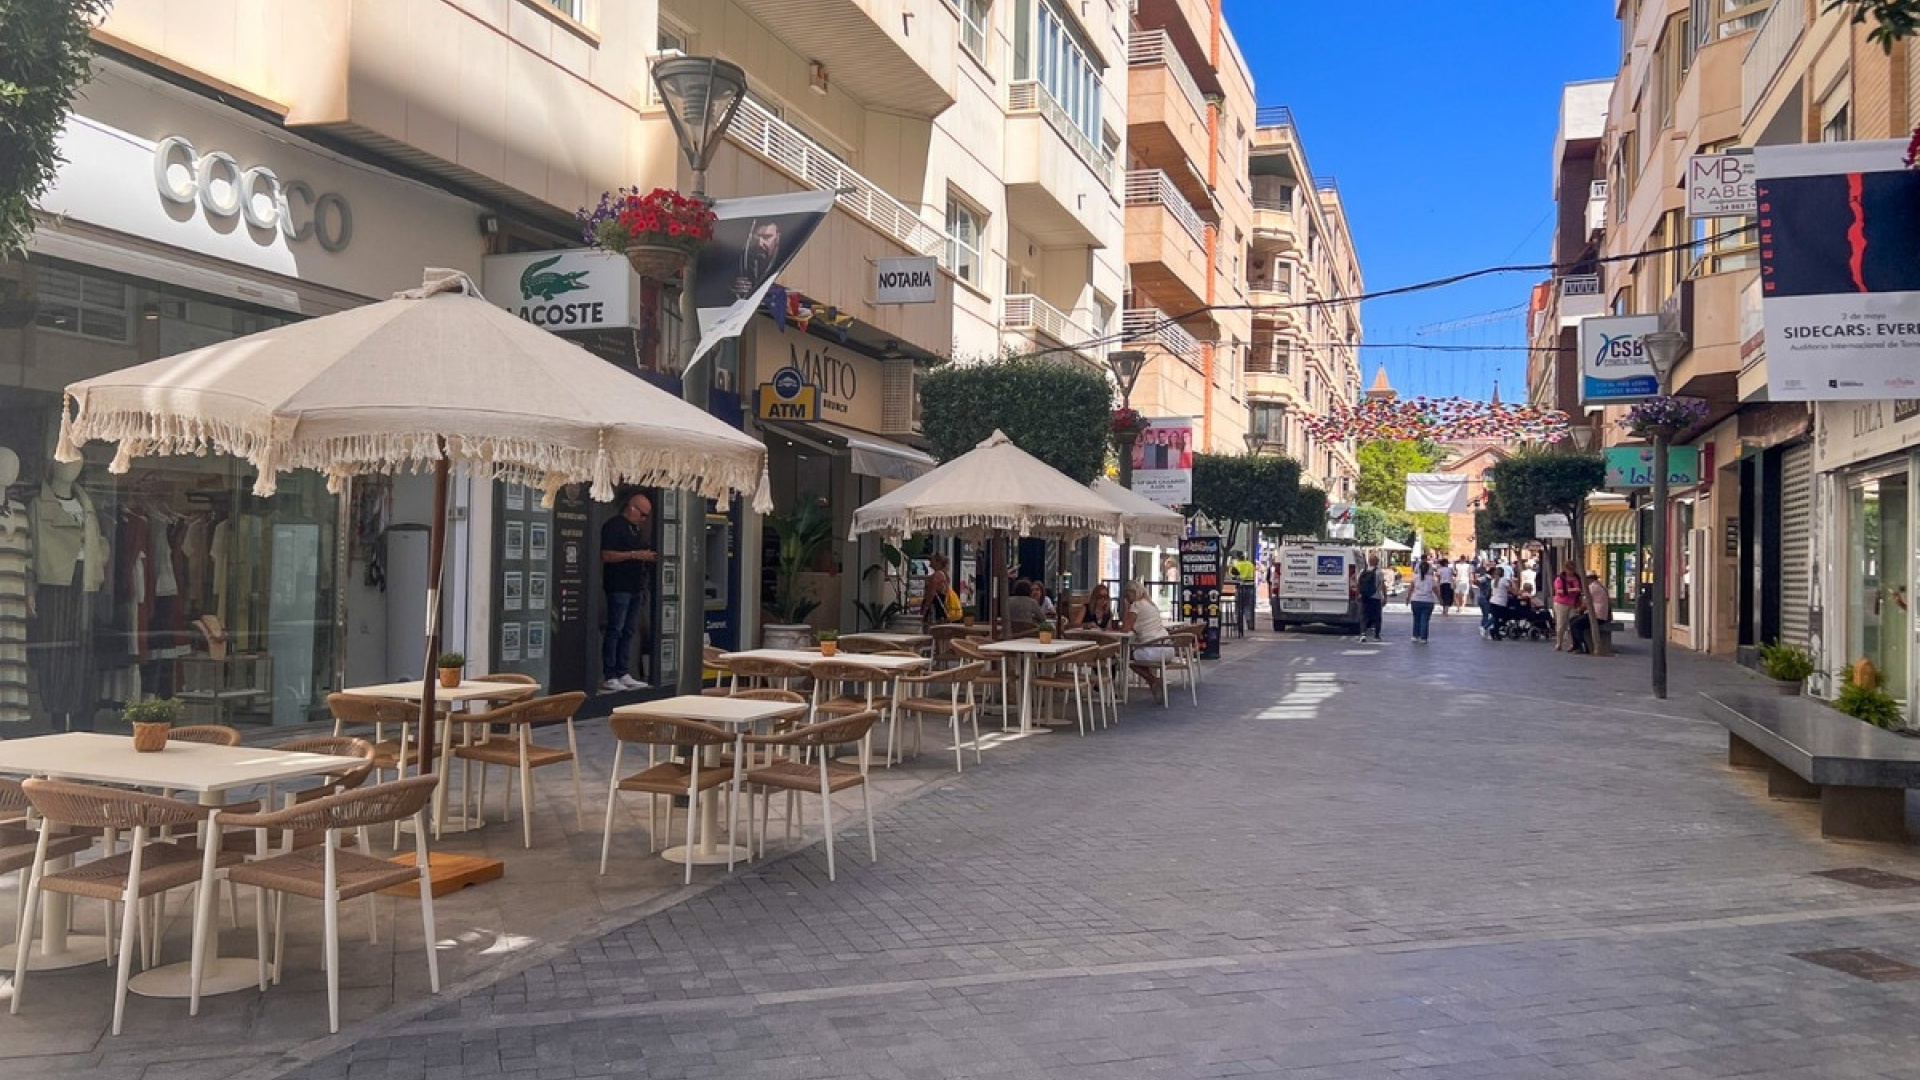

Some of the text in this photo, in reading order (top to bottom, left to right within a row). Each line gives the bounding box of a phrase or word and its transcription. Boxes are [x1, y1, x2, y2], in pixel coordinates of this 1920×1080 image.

[1694, 157, 1743, 184] MB
[155, 136, 353, 252] COCCO
[878, 271, 932, 289] NOTARIA
[506, 301, 604, 325] ACOSTE
[1783, 323, 1871, 339] SIDECARS:
[1611, 340, 1643, 357] CSB
[768, 403, 806, 418] ATM
